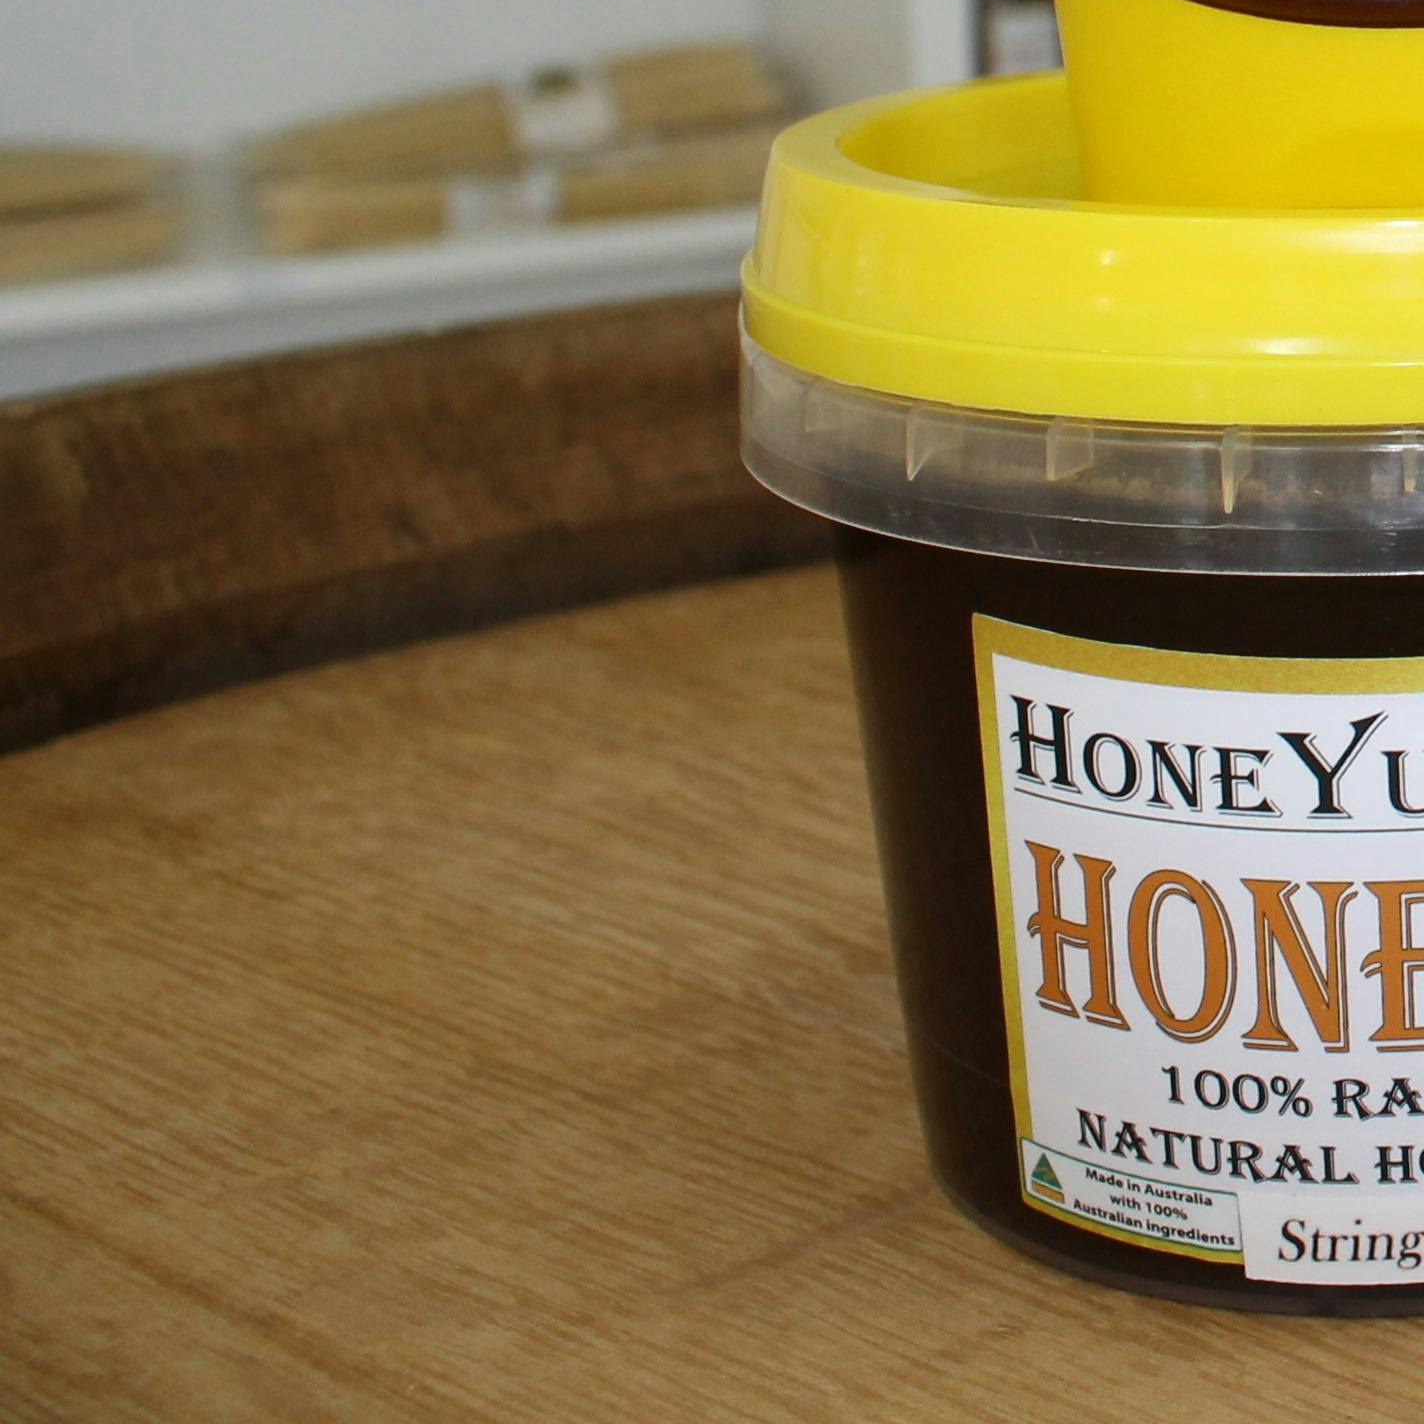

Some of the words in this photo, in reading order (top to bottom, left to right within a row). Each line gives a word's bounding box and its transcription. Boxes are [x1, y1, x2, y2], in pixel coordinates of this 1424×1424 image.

[1161, 1065, 1314, 1119] 100%
[1076, 1107, 1358, 1185] NATURAL
[1085, 1167, 1123, 1189] Made
[1127, 1179, 1141, 1193] in
[1144, 1185, 1213, 1207] Australia
[1109, 1194, 1141, 1211] with
[1146, 1201, 1188, 1220] 100%
[1073, 1198, 1143, 1229] Australian
[1146, 1219, 1235, 1246] ingredients
